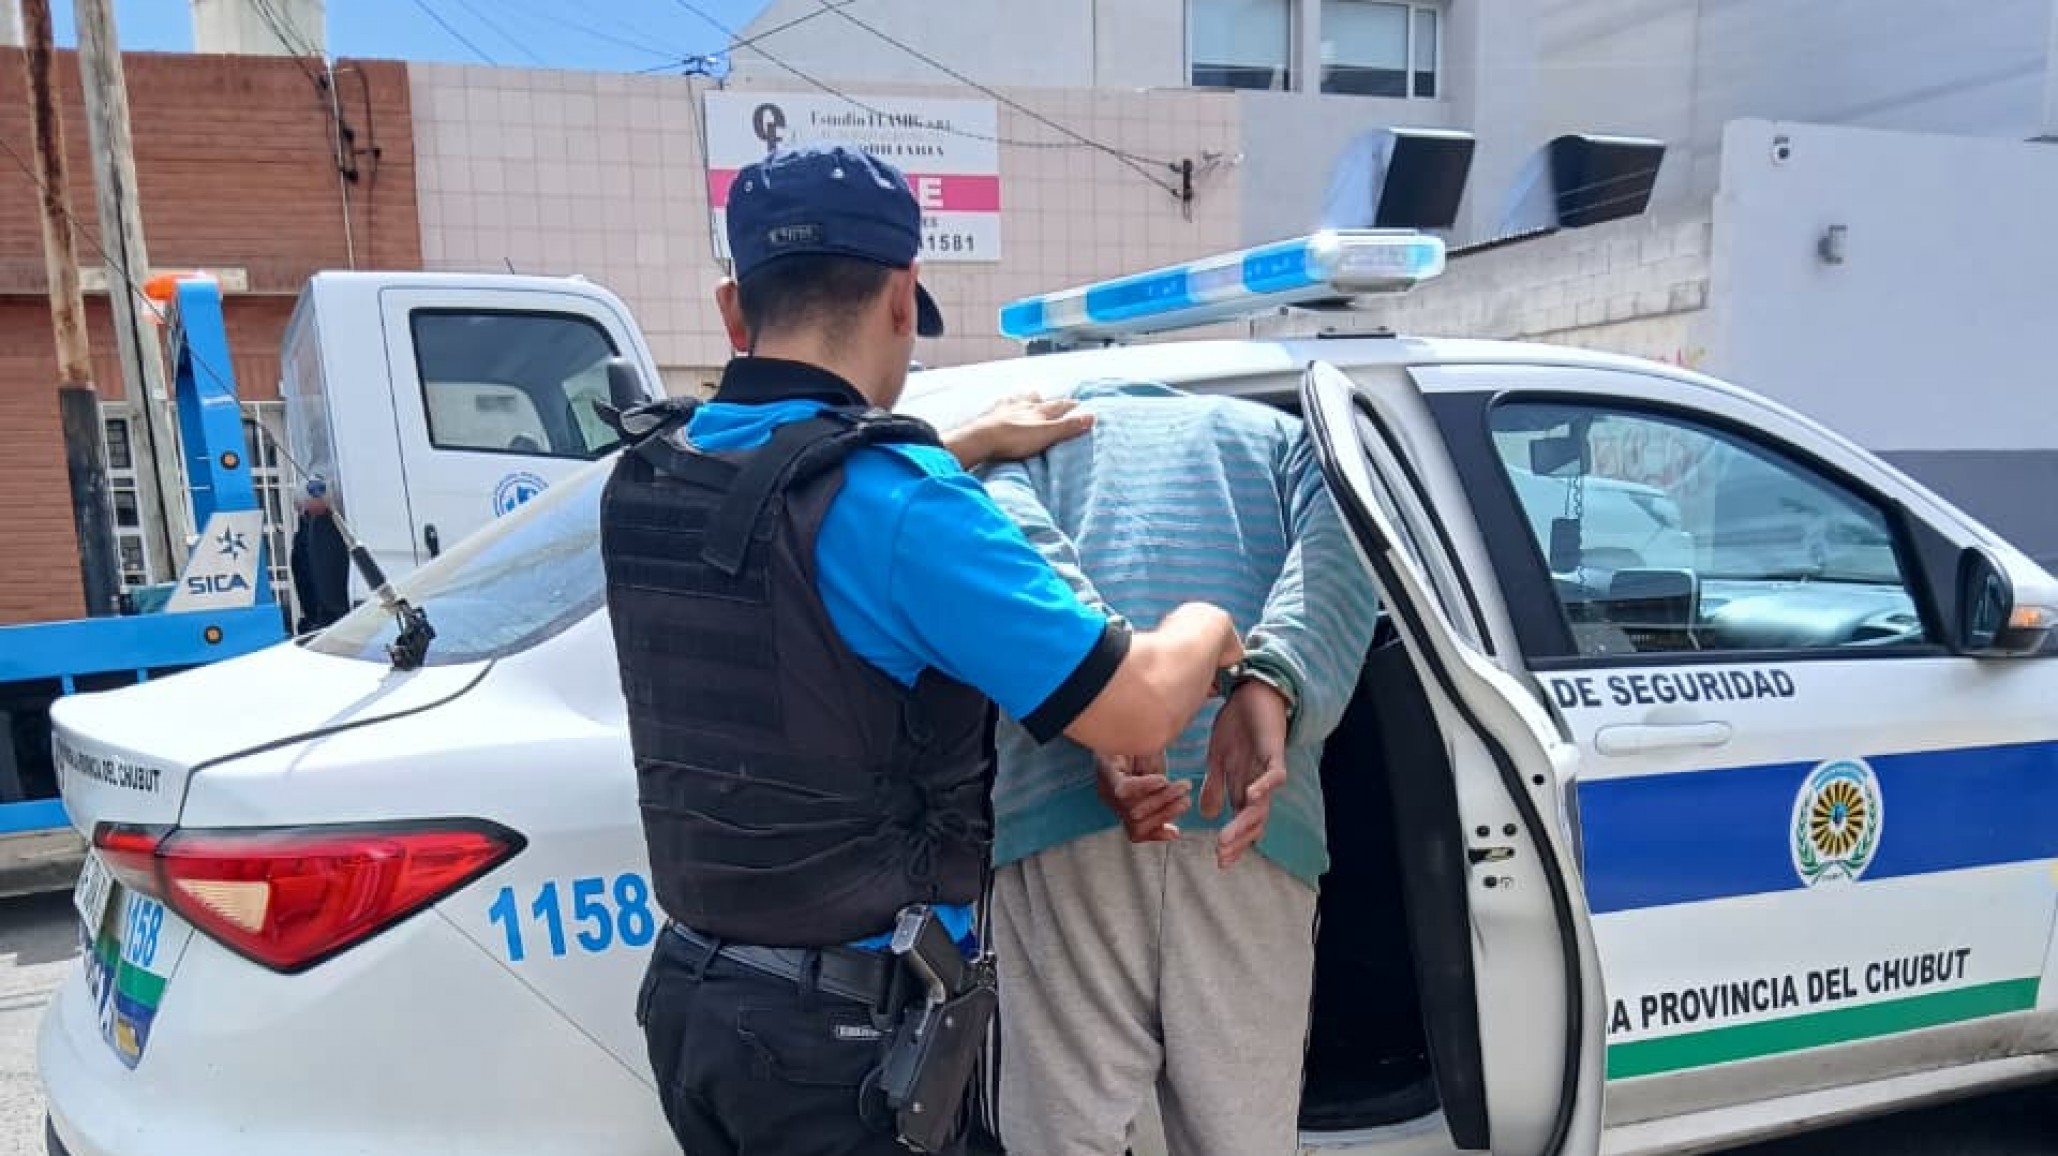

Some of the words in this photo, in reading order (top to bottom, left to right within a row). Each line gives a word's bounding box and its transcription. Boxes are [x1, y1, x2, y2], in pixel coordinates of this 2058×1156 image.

[918, 177, 944, 208] E
[187, 573, 250, 595] SICA
[1550, 677, 1602, 708] DE
[1607, 668, 1795, 706] SEGURIDAD
[488, 873, 655, 962] 1158
[1607, 998, 1632, 1035] A
[1641, 974, 1799, 1030] PROVINCIA
[1806, 965, 1857, 1003] DEL
[1865, 947, 1971, 994] CHUBUT
